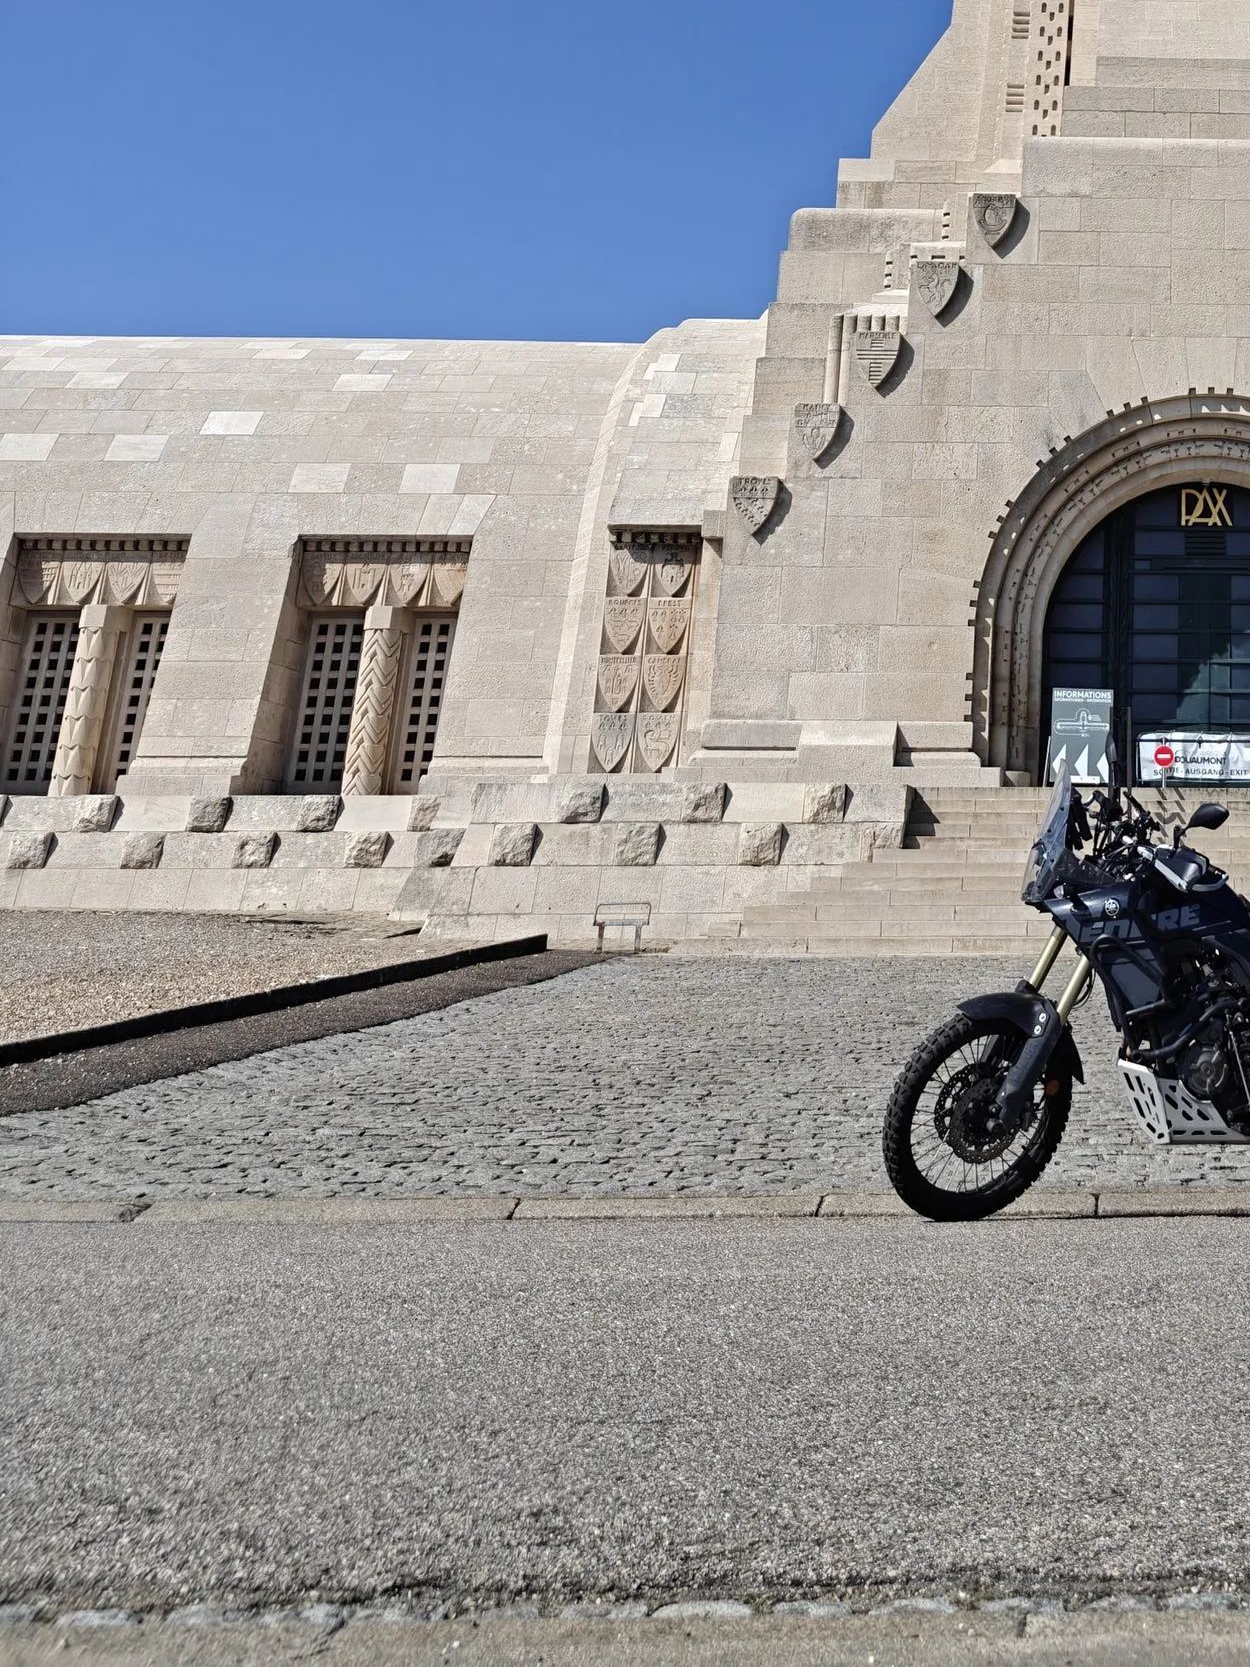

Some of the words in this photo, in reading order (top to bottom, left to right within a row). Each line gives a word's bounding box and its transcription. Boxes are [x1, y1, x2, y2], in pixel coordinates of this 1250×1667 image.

[1181, 488, 1233, 526] PAX
[1054, 690, 1112, 699] INFORMATIONS
[1174, 756, 1227, 765] DOUAUMONT
[1185, 768, 1224, 776] AUSGANG
